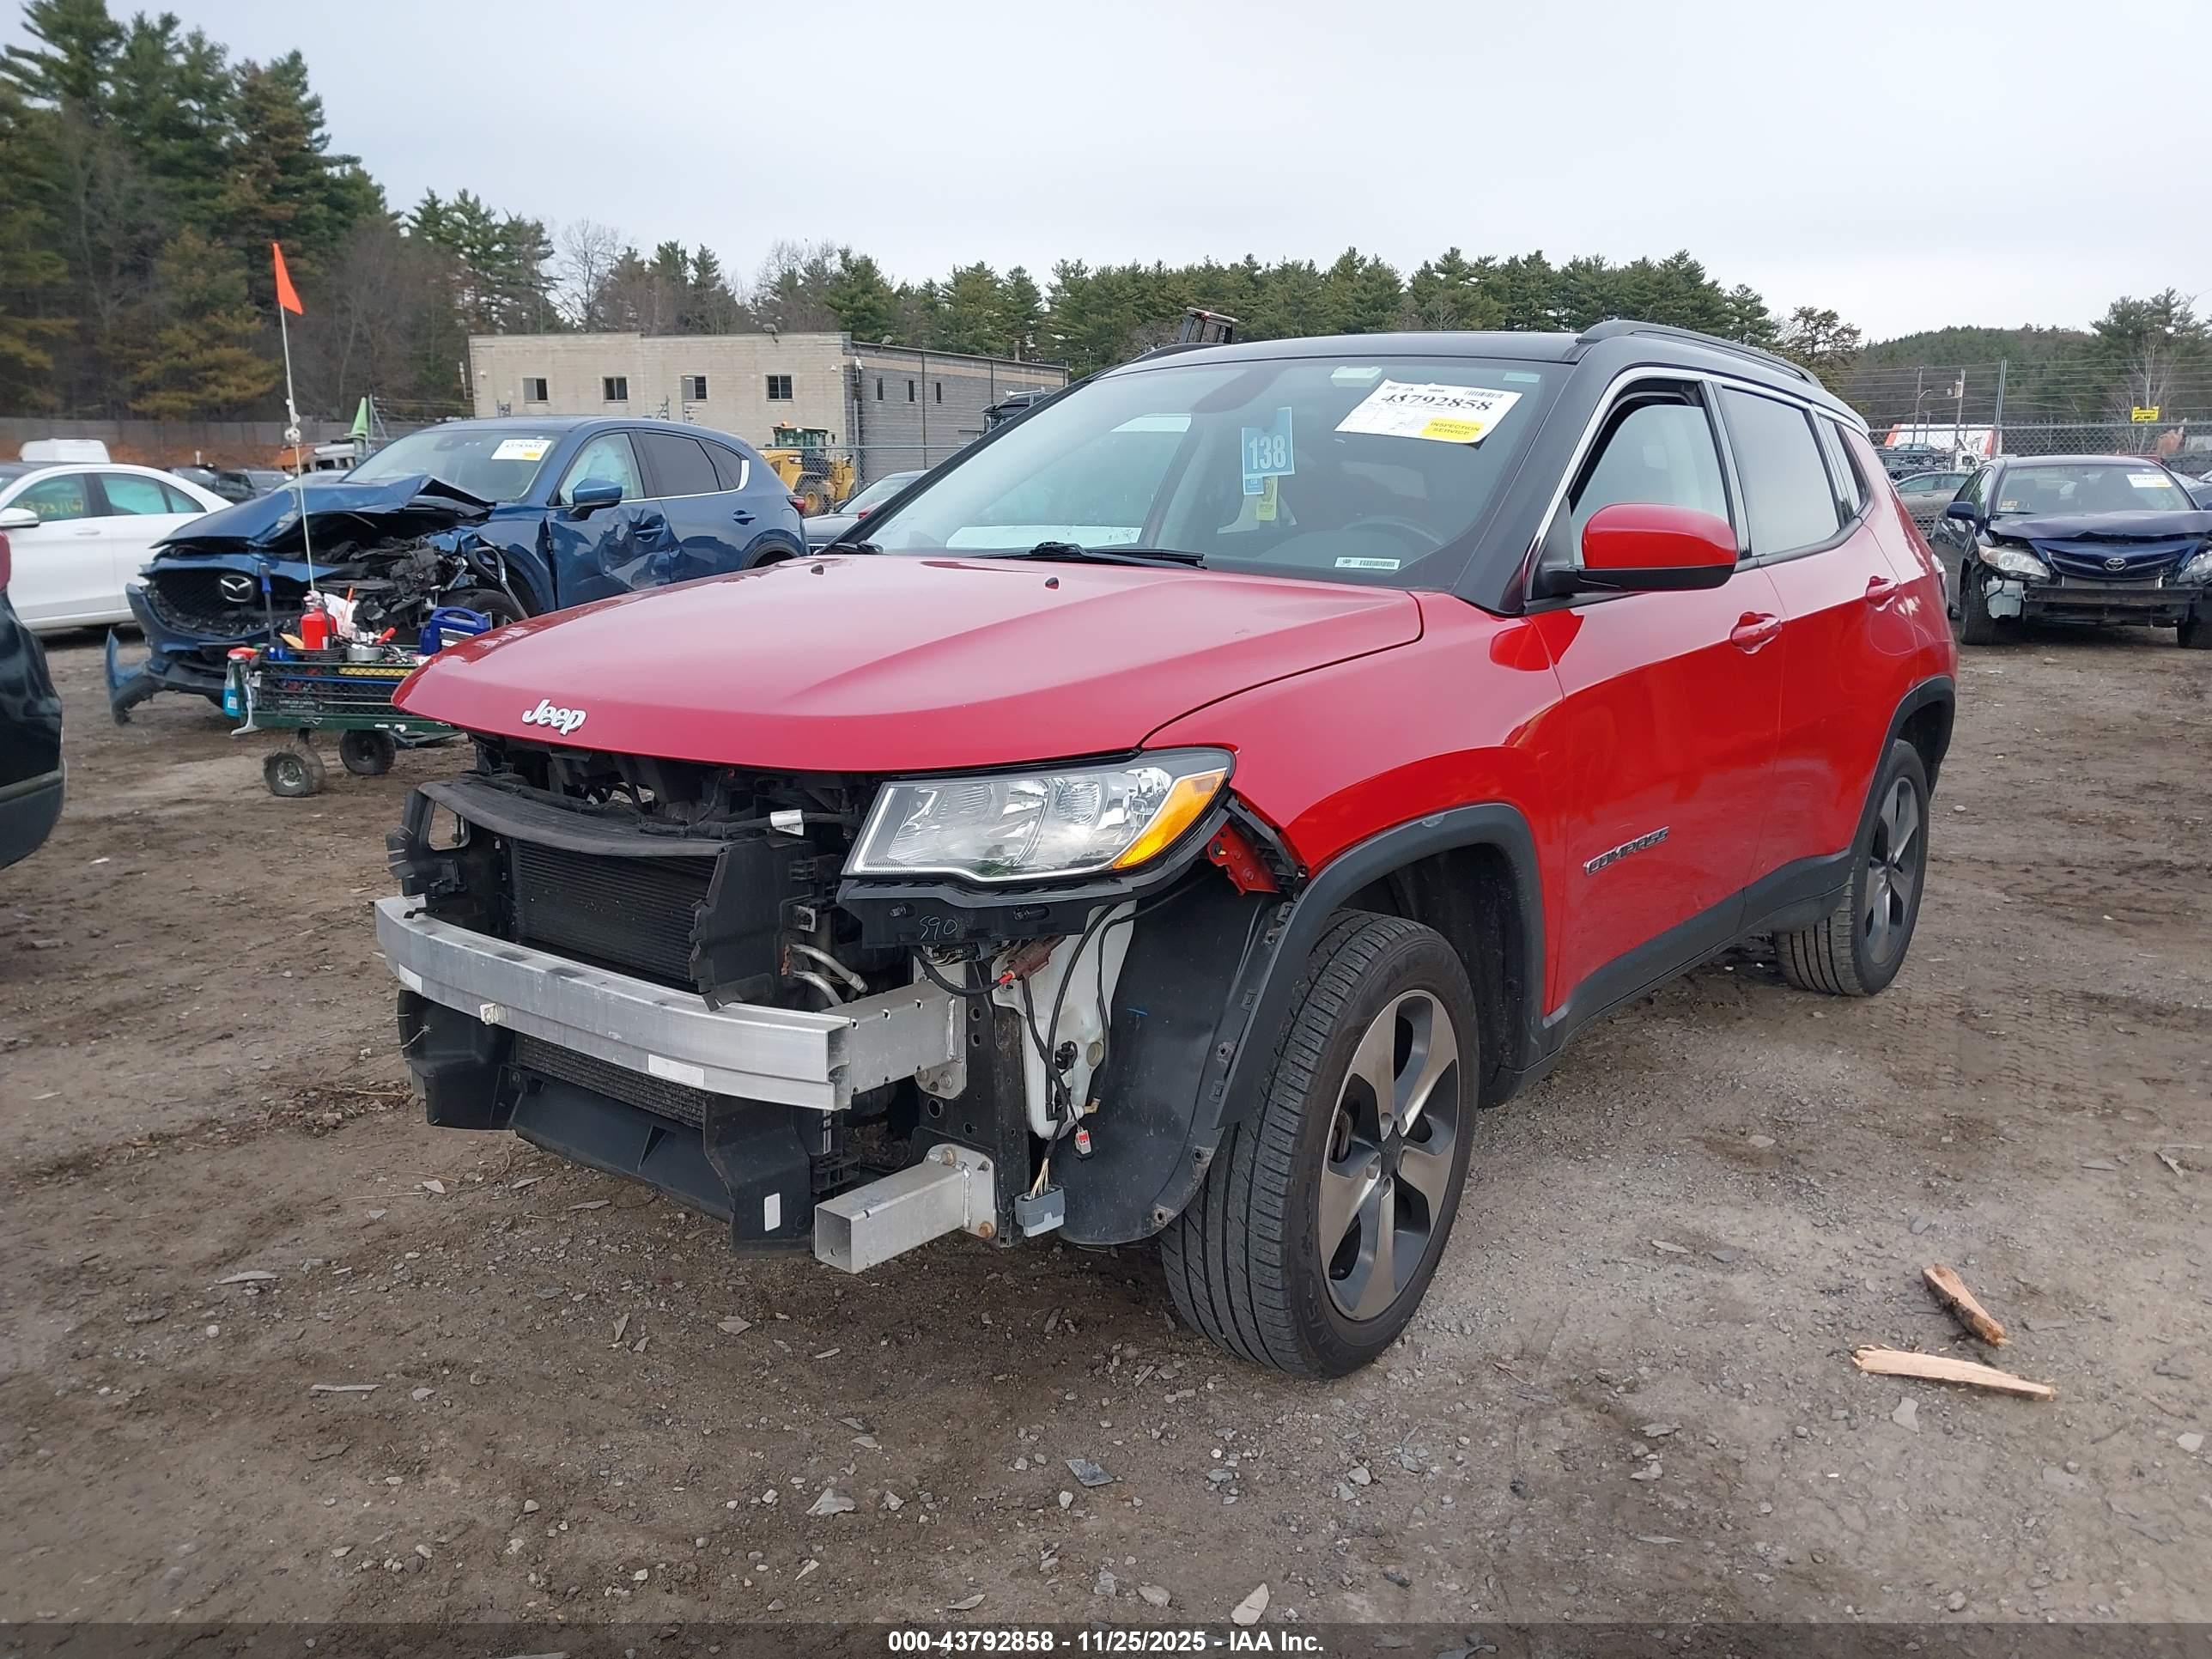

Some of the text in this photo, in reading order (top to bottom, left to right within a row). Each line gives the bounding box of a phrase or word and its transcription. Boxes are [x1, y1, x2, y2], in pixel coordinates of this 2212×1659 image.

[1381, 393, 1493, 411] 43792858
[1430, 421, 1480, 432] INSPECTION
[1432, 427, 1470, 435] SERVICE
[1249, 434, 1286, 470] 138
[521, 698, 587, 736] Jeep
